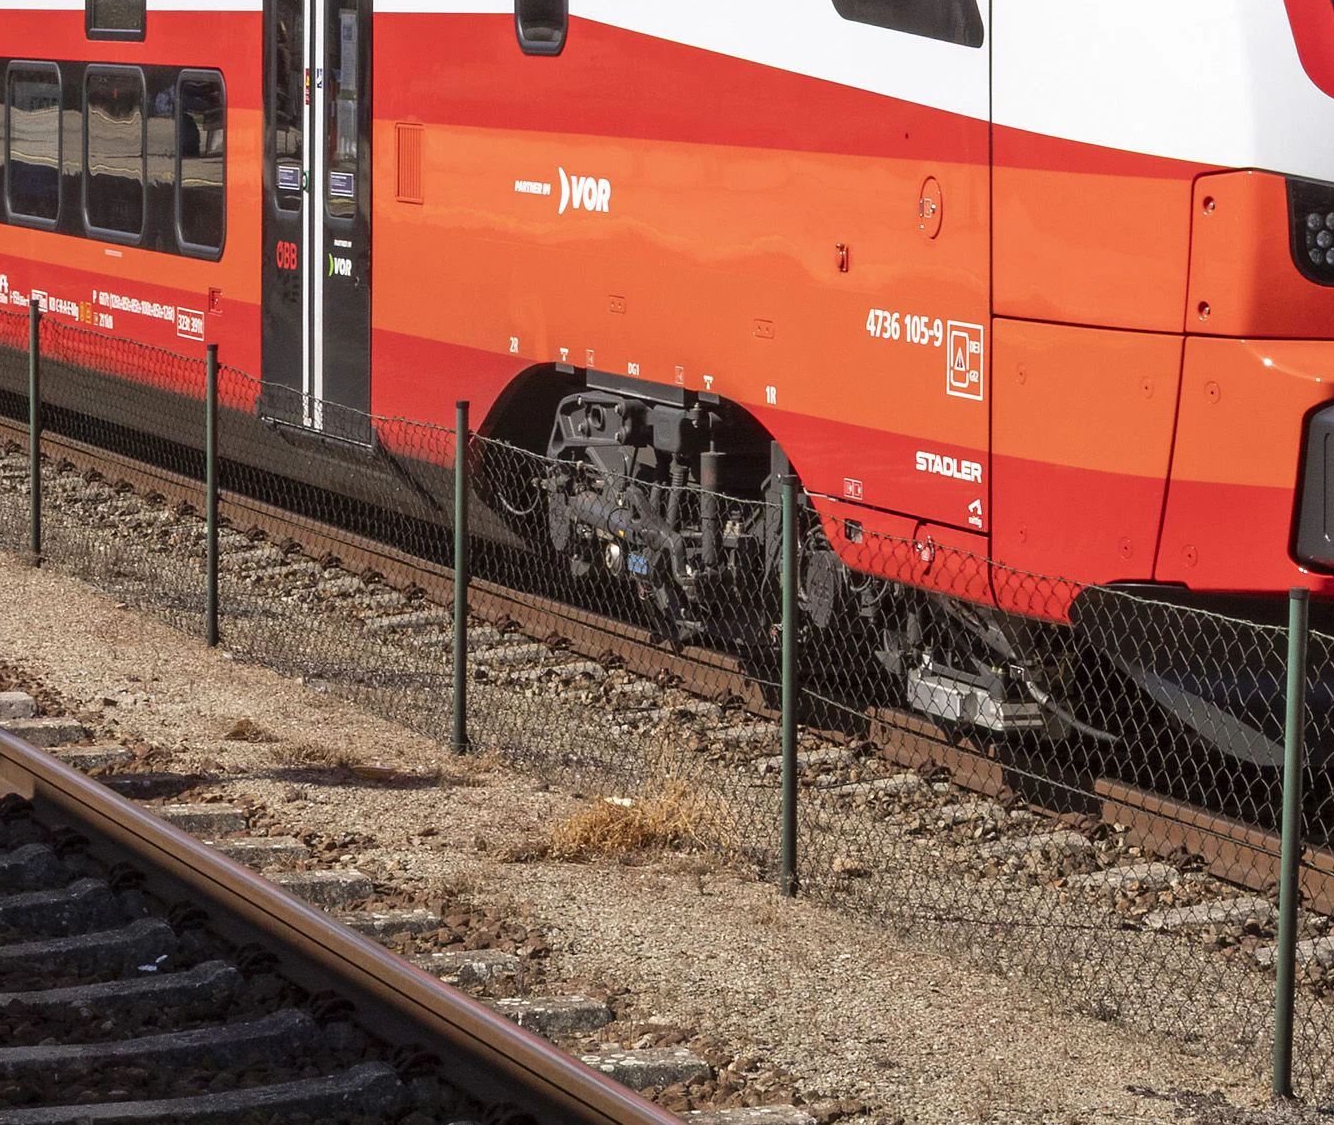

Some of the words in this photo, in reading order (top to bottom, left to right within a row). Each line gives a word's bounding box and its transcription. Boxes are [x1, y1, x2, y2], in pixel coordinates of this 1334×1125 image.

[570, 175, 611, 213] VOR
[276, 240, 298, 270] ÖBB
[333, 257, 353, 277] VOR
[865, 308, 901, 341] 4736
[904, 314, 944, 348] 105-9
[765, 385, 777, 405] 1R
[915, 450, 982, 483] STADLER
